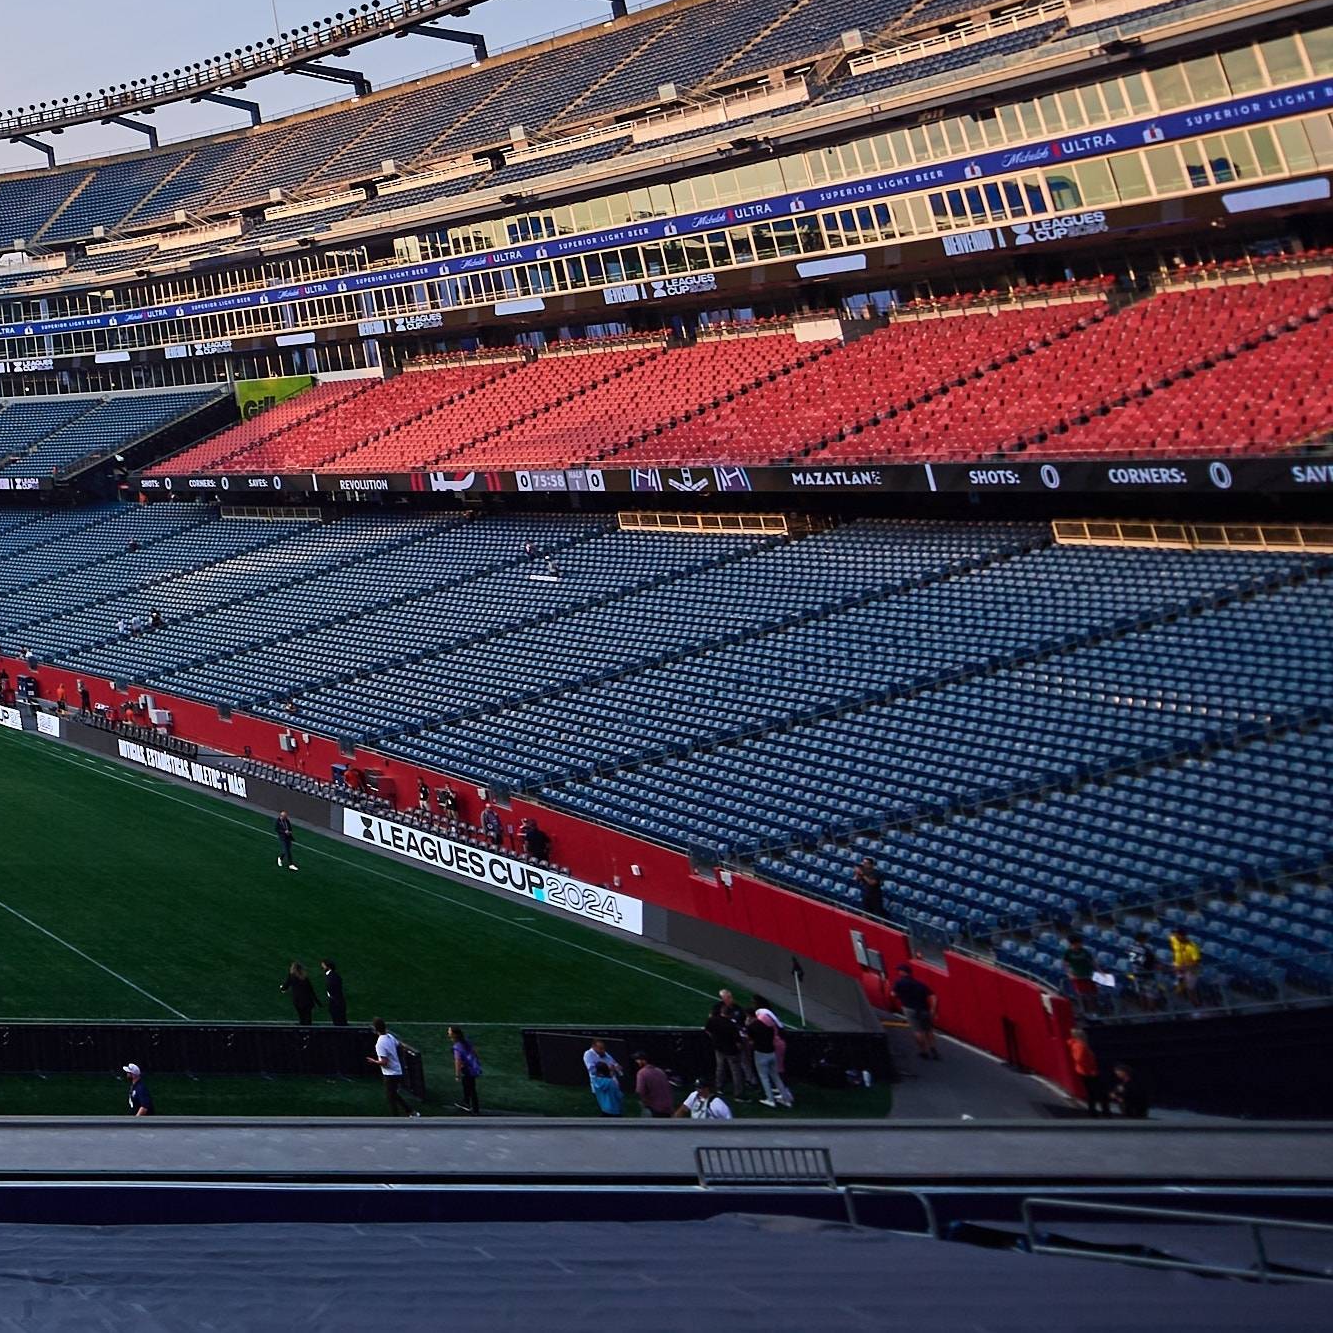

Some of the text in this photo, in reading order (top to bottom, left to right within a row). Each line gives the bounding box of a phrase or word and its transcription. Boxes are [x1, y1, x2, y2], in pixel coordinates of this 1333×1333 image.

[1185, 102, 1262, 128] SUPERIOR
[1269, 91, 1317, 112] LIGHT
[1061, 132, 1118, 155] ULTRA
[820, 169, 944, 202] SUPERIOR LIGHT BEER
[734, 203, 773, 220] ULTRA
[1032, 211, 1106, 235] LEAGUES
[1035, 227, 1068, 243] CUP
[493, 250, 523, 263] ULTRA
[665, 273, 716, 290] LEAGUES
[667, 284, 690, 296] CUP
[141, 478, 161, 489] SHOTS:
[188, 478, 217, 489] CORNERS:
[248, 478, 269, 489] SAVES:
[339, 478, 388, 491] REVOLUTION
[519, 472, 529, 489] 0
[534, 473, 565, 488] 75:58
[590, 472, 600, 489] 0
[969, 469, 1020, 486] SHOTS:
[1040, 463, 1060, 489] 0
[1108, 467, 1187, 485] CORNERS:
[1209, 462, 1233, 491] 0
[378, 822, 623, 923] LEAGUES CUP 2024
